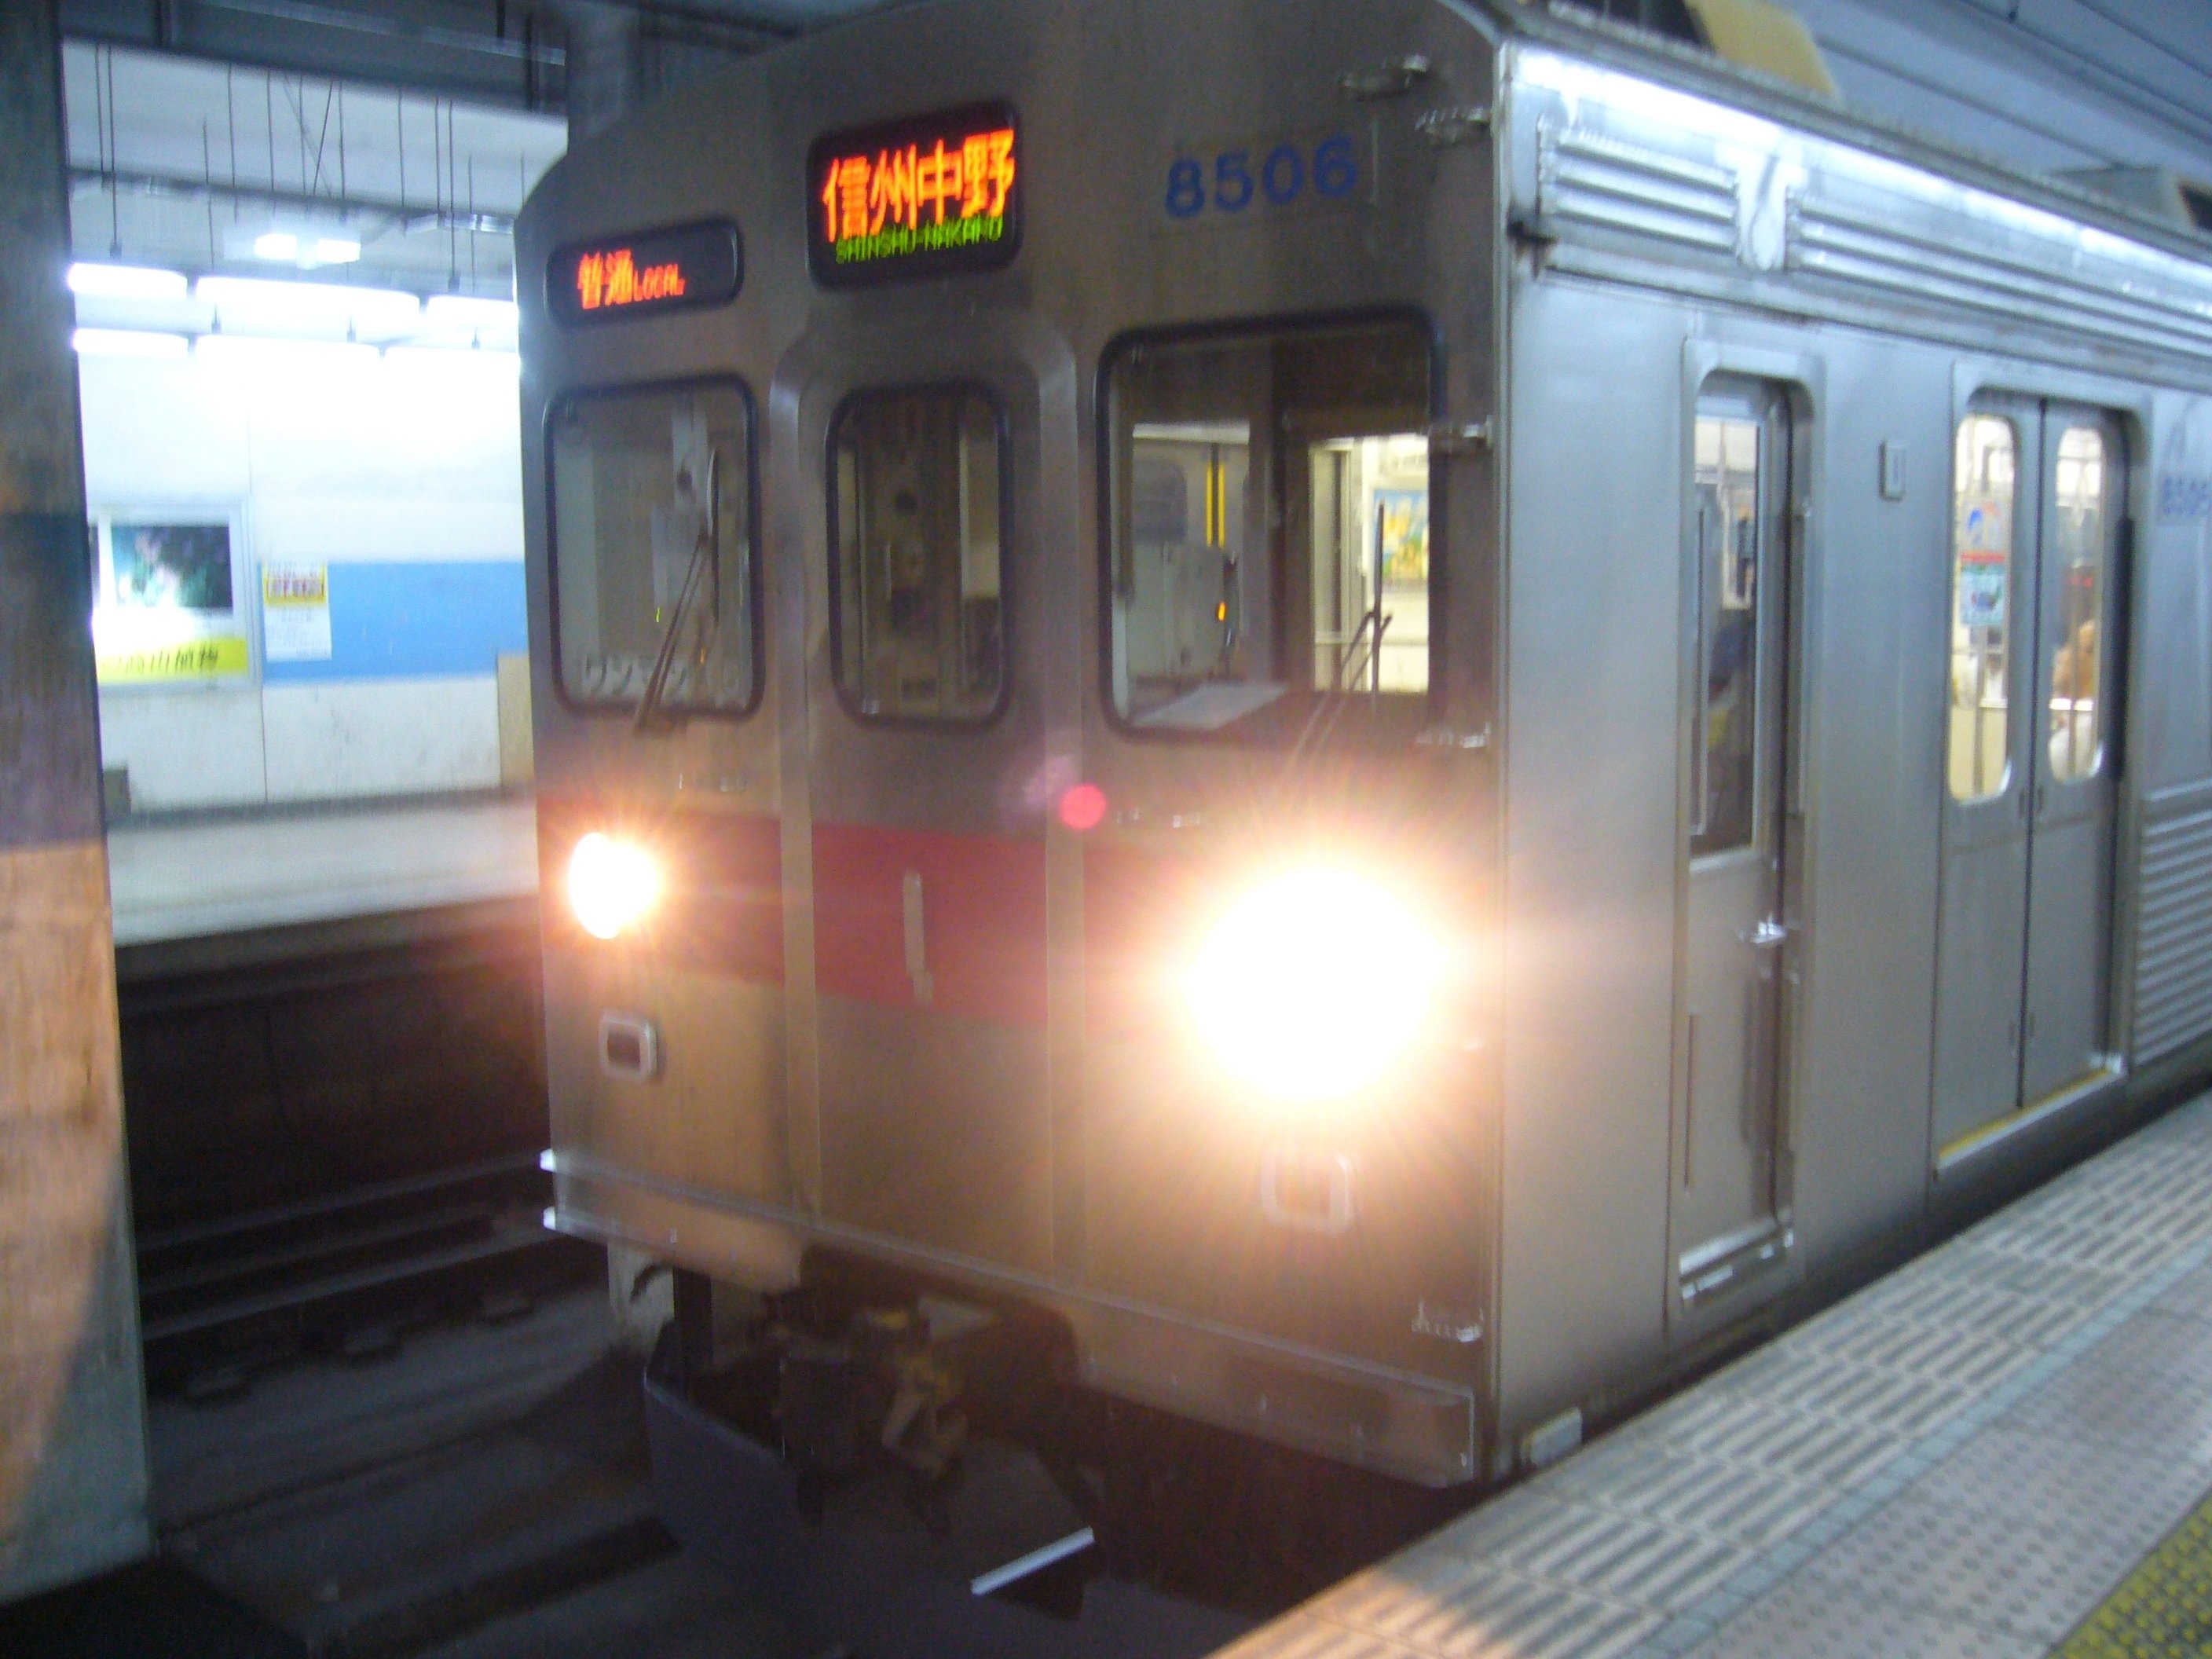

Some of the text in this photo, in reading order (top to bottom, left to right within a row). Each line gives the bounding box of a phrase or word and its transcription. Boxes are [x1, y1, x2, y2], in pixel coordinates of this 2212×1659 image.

[822, 129, 1015, 243] 信州中野
[1164, 132, 1358, 218] 8506
